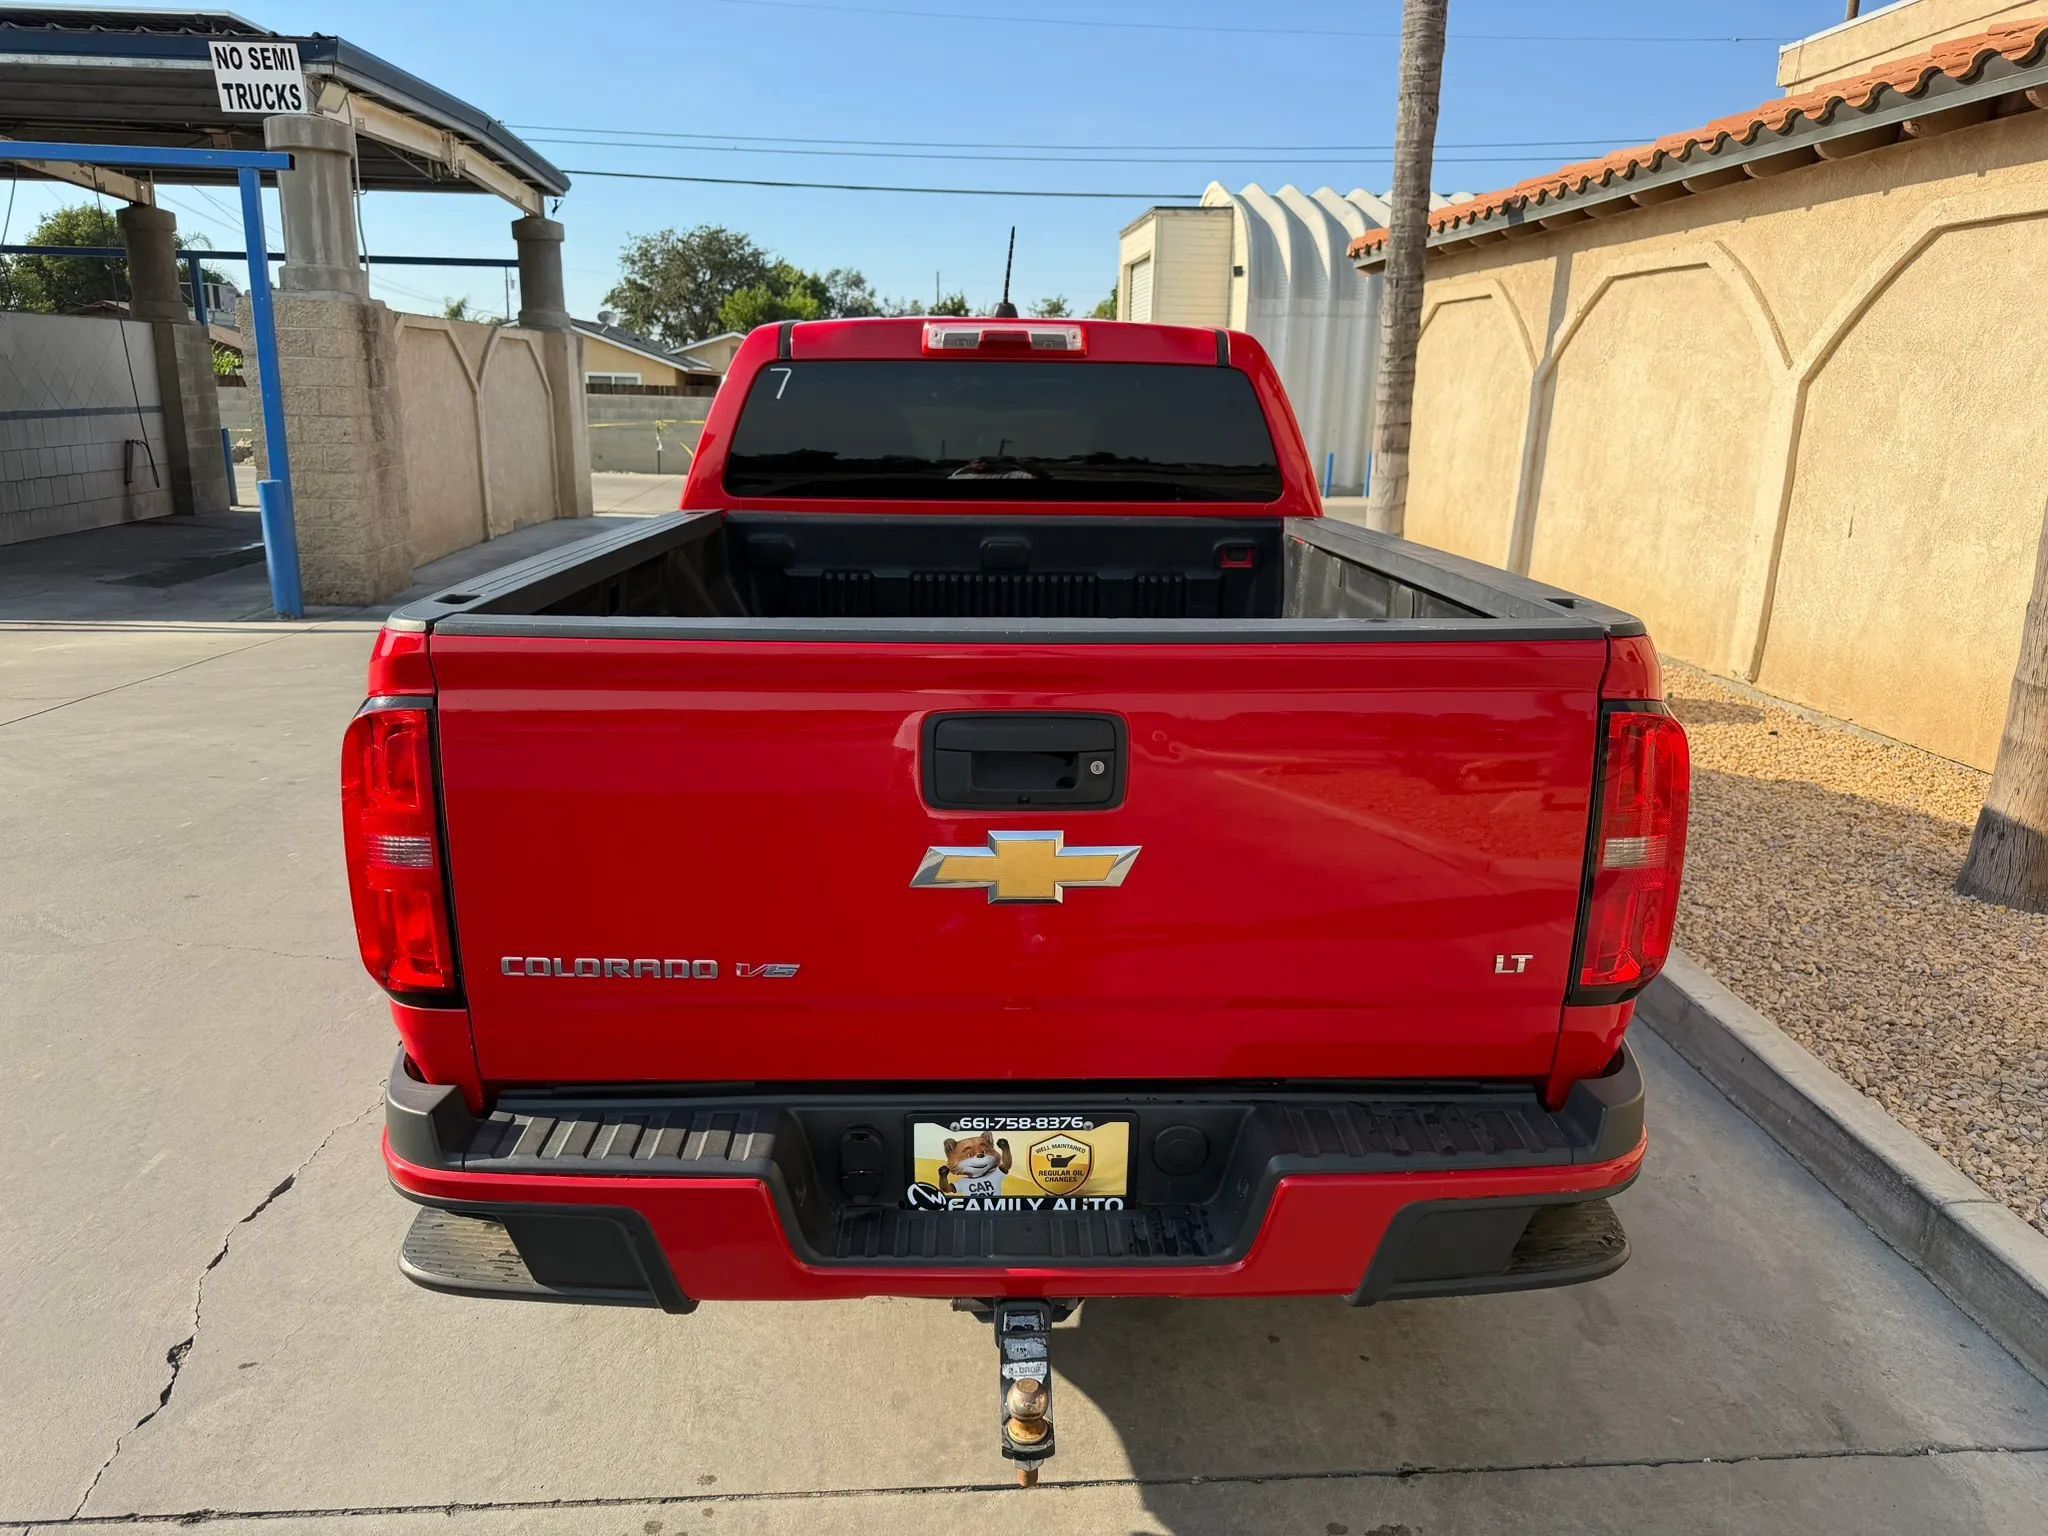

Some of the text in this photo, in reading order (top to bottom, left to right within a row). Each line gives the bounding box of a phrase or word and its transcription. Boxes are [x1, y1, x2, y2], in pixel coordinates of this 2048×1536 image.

[214, 46, 295, 71] NO SEMI
[222, 83, 302, 111] TRUCKS
[770, 368, 792, 399] 7
[501, 956, 801, 979] COLORADO V6
[1495, 954, 1533, 973] LT
[959, 1116, 1083, 1130] 661-758-8376
[1035, 1143, 1086, 1154] WELL MAINTAINED
[968, 1180, 995, 1193] CAR
